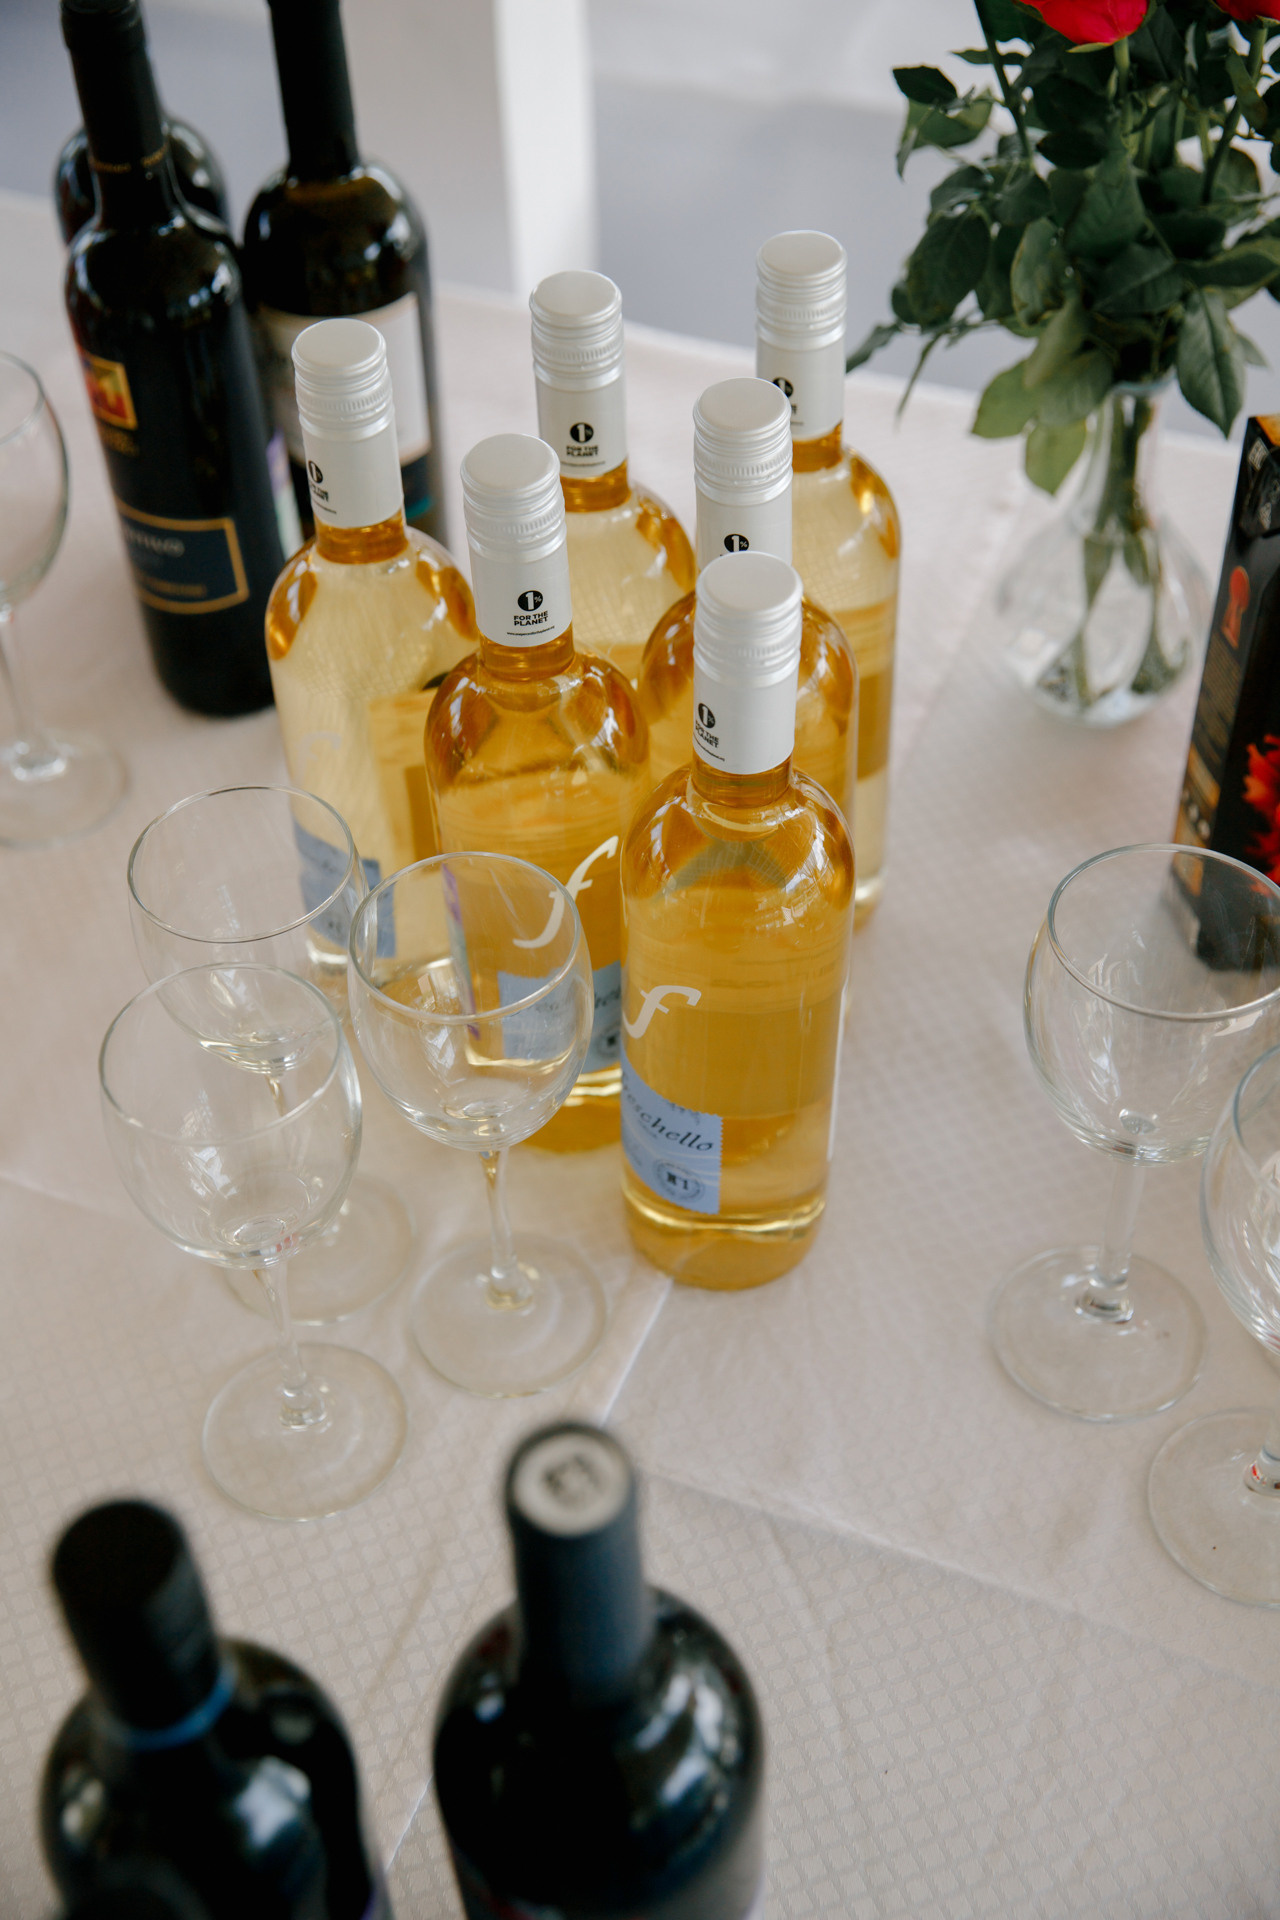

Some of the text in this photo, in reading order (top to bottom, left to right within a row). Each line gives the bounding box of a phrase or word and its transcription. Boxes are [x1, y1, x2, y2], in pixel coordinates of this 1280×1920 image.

[525, 591, 542, 610] 1%
[514, 616, 549, 626] PLANET
[532, 610, 549, 619] THE
[512, 835, 619, 949] f
[622, 985, 702, 1039] f
